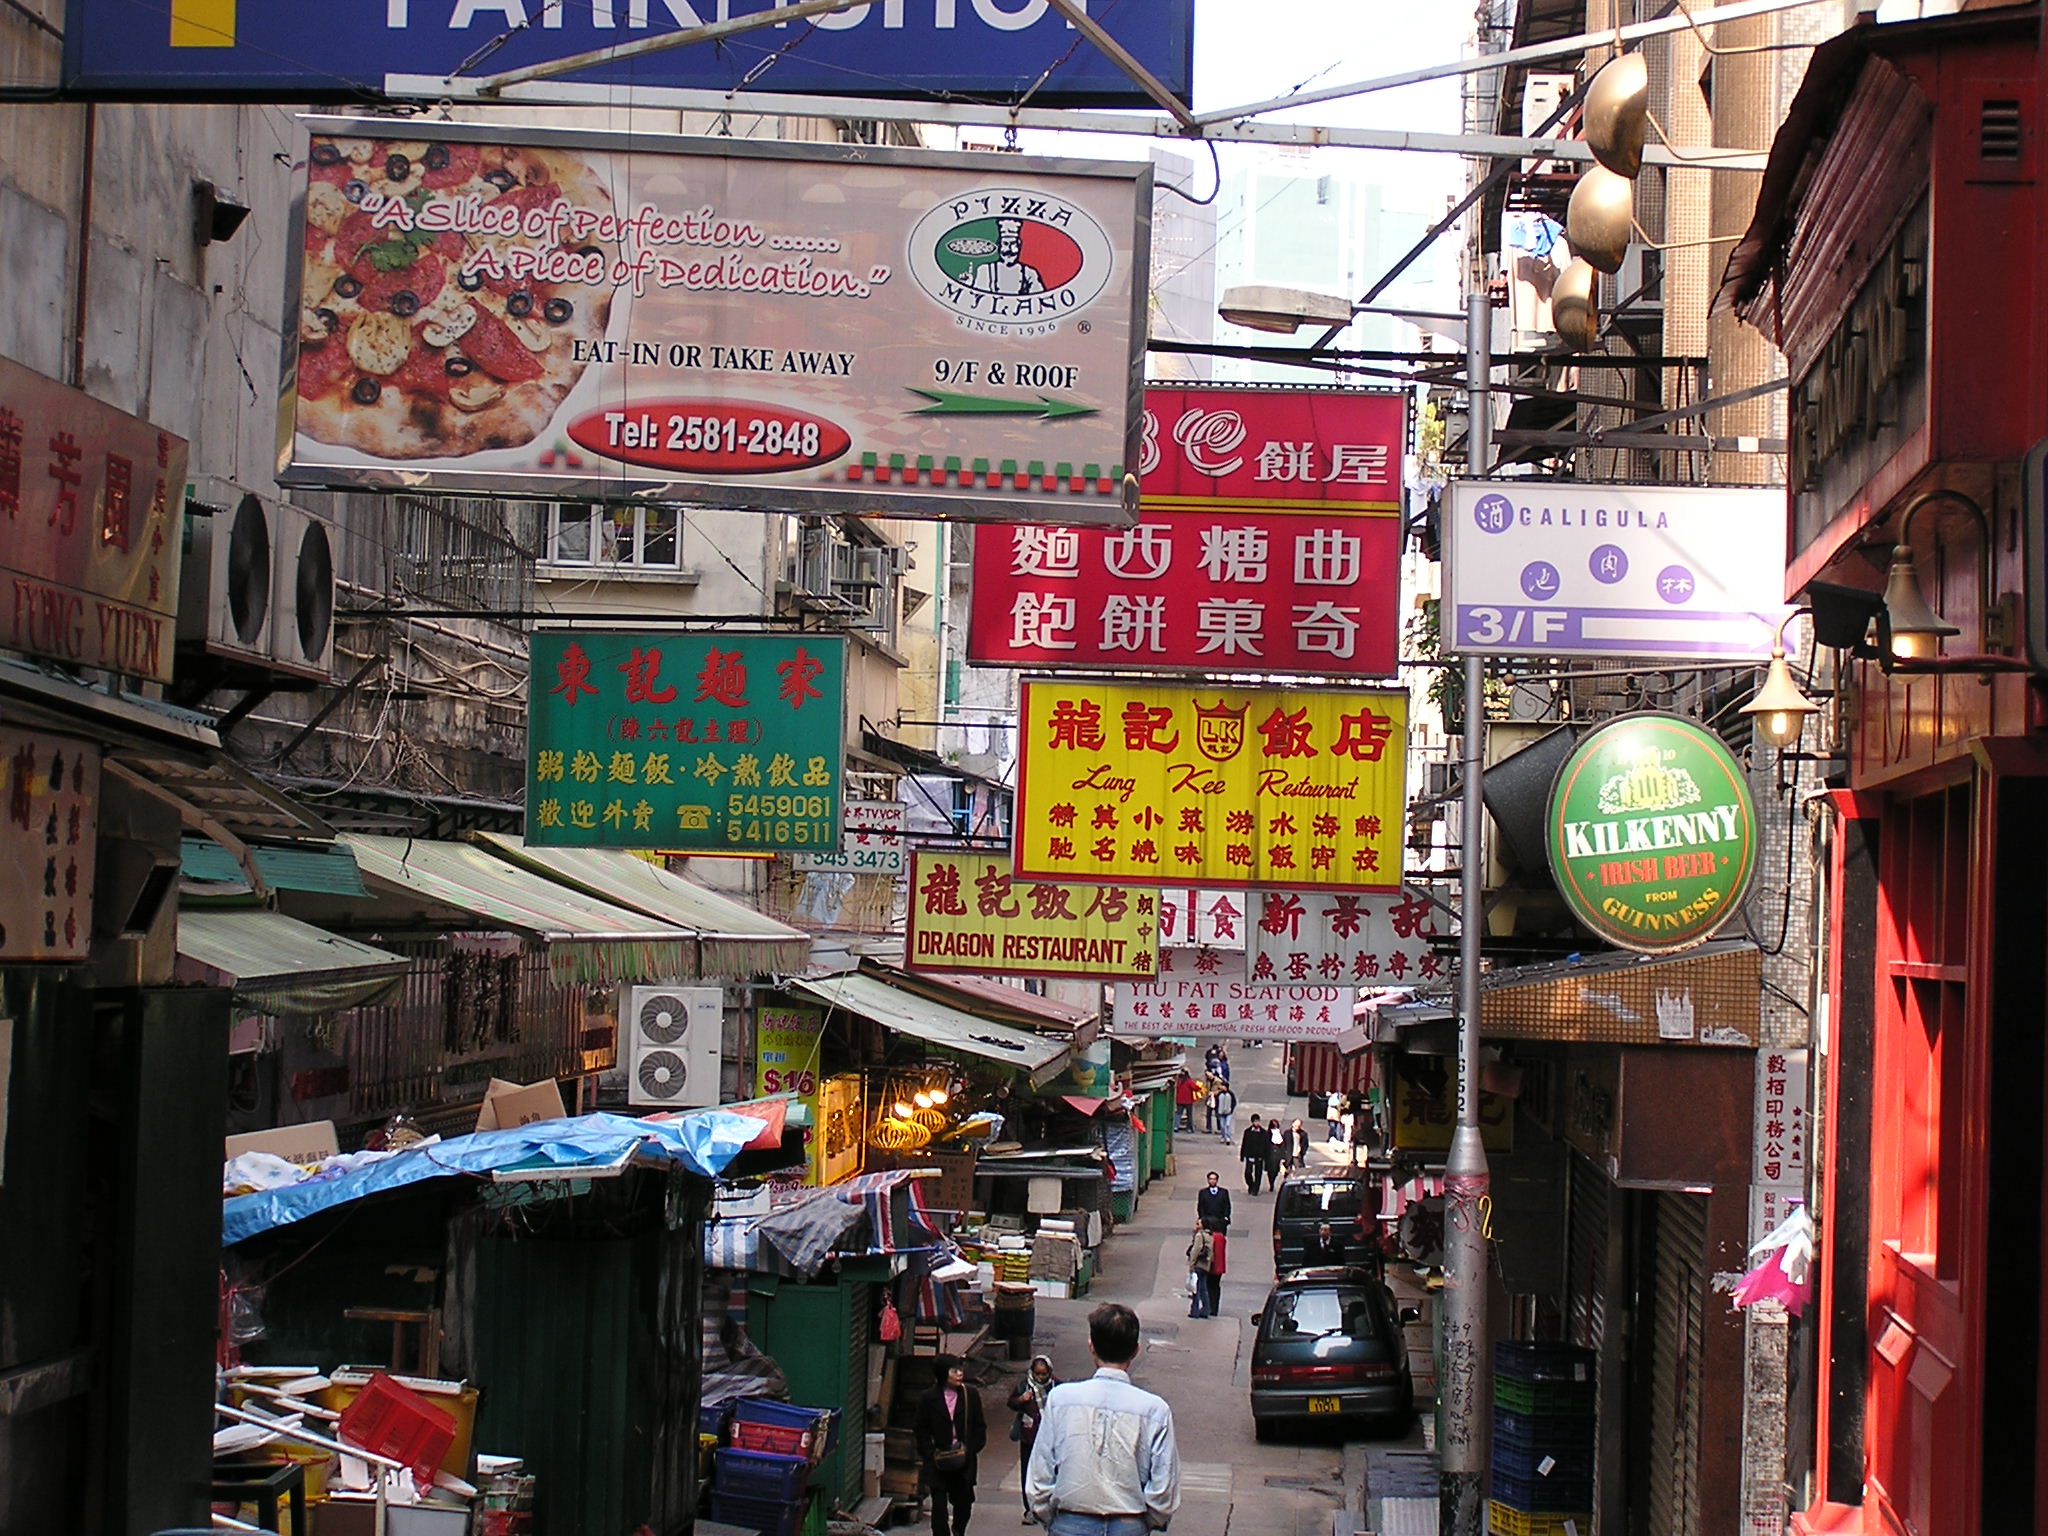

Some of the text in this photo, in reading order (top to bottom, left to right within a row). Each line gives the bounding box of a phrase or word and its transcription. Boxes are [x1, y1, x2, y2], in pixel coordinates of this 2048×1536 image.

[421, 195, 519, 233] Slice
[528, 202, 568, 245] of
[574, 206, 761, 248] Perfection
[949, 195, 1073, 228] PIZZA
[467, 249, 500, 276] A
[511, 245, 601, 282] Piece
[611, 250, 652, 292] of
[939, 282, 1076, 317] MILANO
[956, 315, 1056, 336] SINCE 1996
[573, 339, 855, 376] EAT-IN OR TAKE AWAY
[934, 359, 1079, 388] 9/F & ROOF
[604, 412, 820, 458] Tel: 2581-2848
[1254, 441, 1390, 484] 餅屋
[1519, 506, 1669, 529] CALIGULA
[1467, 606, 1569, 645] 3/F
[1202, 719, 1239, 744] LK
[1257, 706, 1393, 762] 飯店
[1072, 763, 1360, 803] Lung Kee Restaurant
[727, 794, 831, 819] 5459061
[727, 819, 830, 845] 5416511
[1563, 804, 1740, 859] KILKENNY
[853, 850, 900, 869] 3473
[1599, 851, 1717, 887] IRISH BEER
[1602, 887, 1721, 931] GUINNESS
[1645, 890, 1678, 903] FROM
[917, 930, 1128, 964] DRAGON RESTAURANT
[1129, 981, 1340, 1002] YIU FAT SEAFOOD
[1141, 1021, 1160, 1031] BEST
[1176, 1022, 1237, 1033] INTERNATIONAL
[1240, 1024, 1265, 1033] FRESH
[1268, 1025, 1304, 1034] SEAFOOD
[763, 1069, 817, 1096] $16
